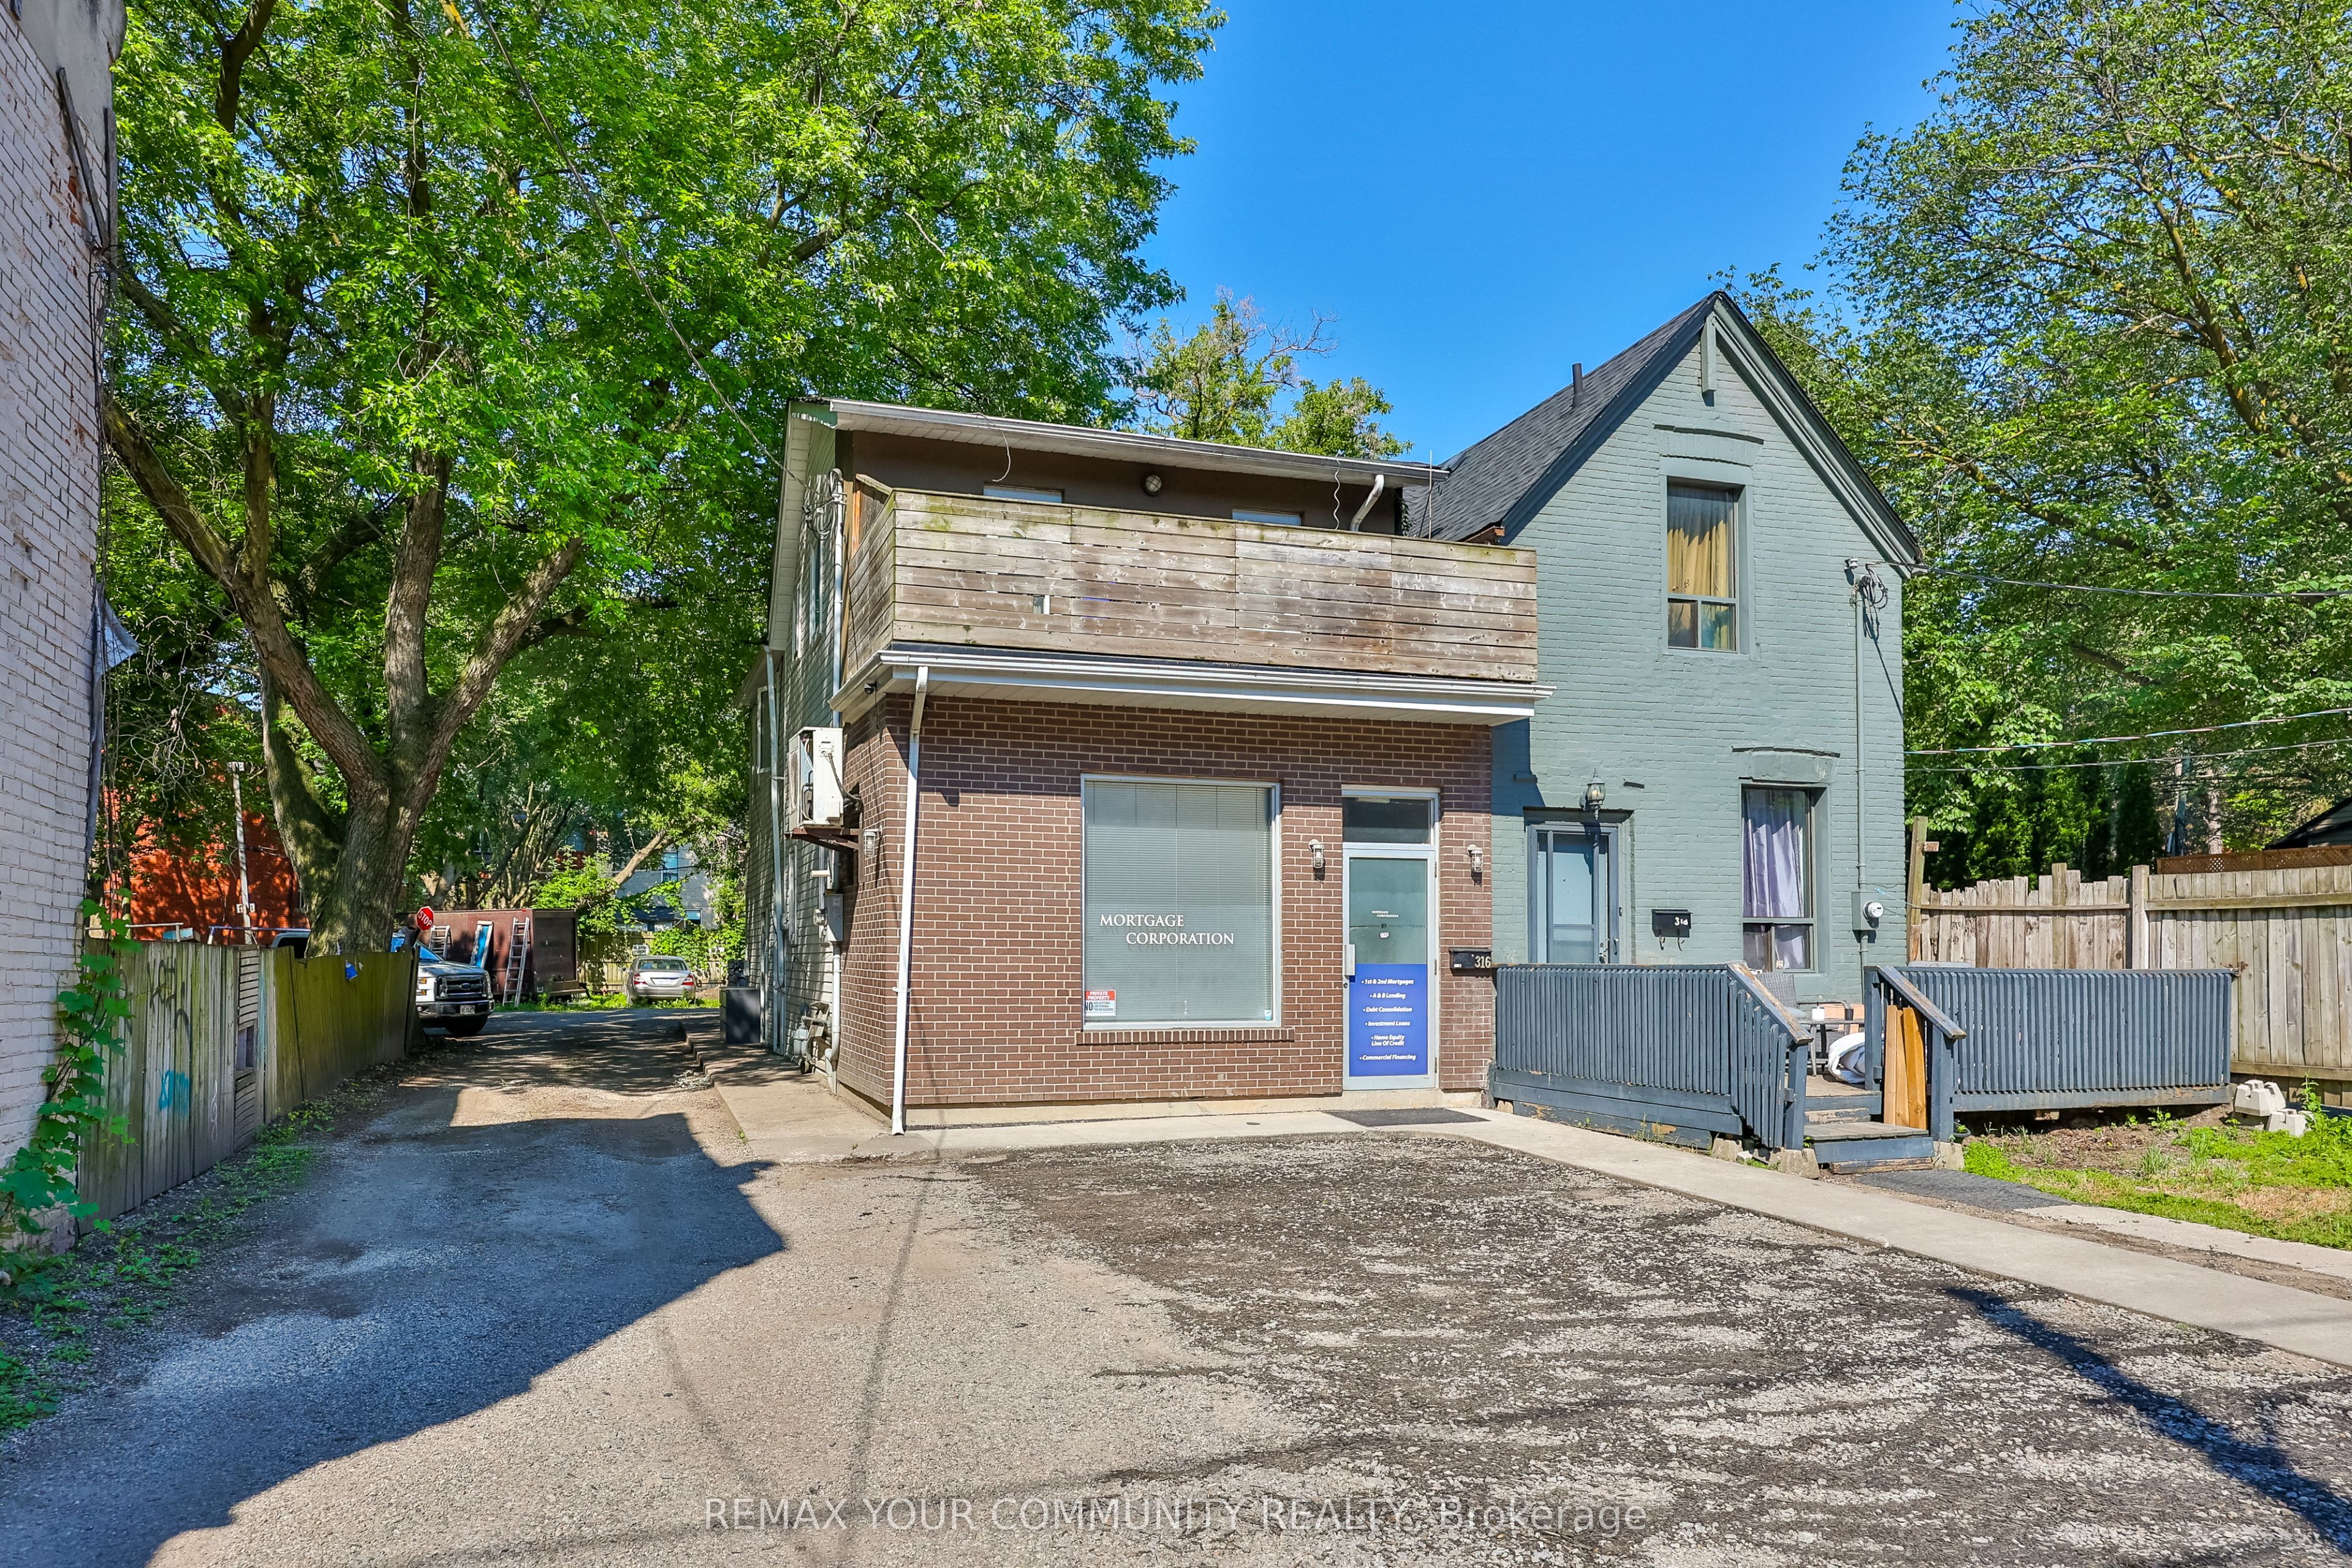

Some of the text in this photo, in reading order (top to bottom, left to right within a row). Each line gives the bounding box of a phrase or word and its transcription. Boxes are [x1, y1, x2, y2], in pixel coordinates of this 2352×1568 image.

[418, 911, 432, 926] STOP
[1099, 914, 1184, 927] MORTGAGE
[1126, 932, 1235, 945] CORPORATION
[1474, 956, 1491, 968] 316
[1085, 1001, 1093, 1011] NO
